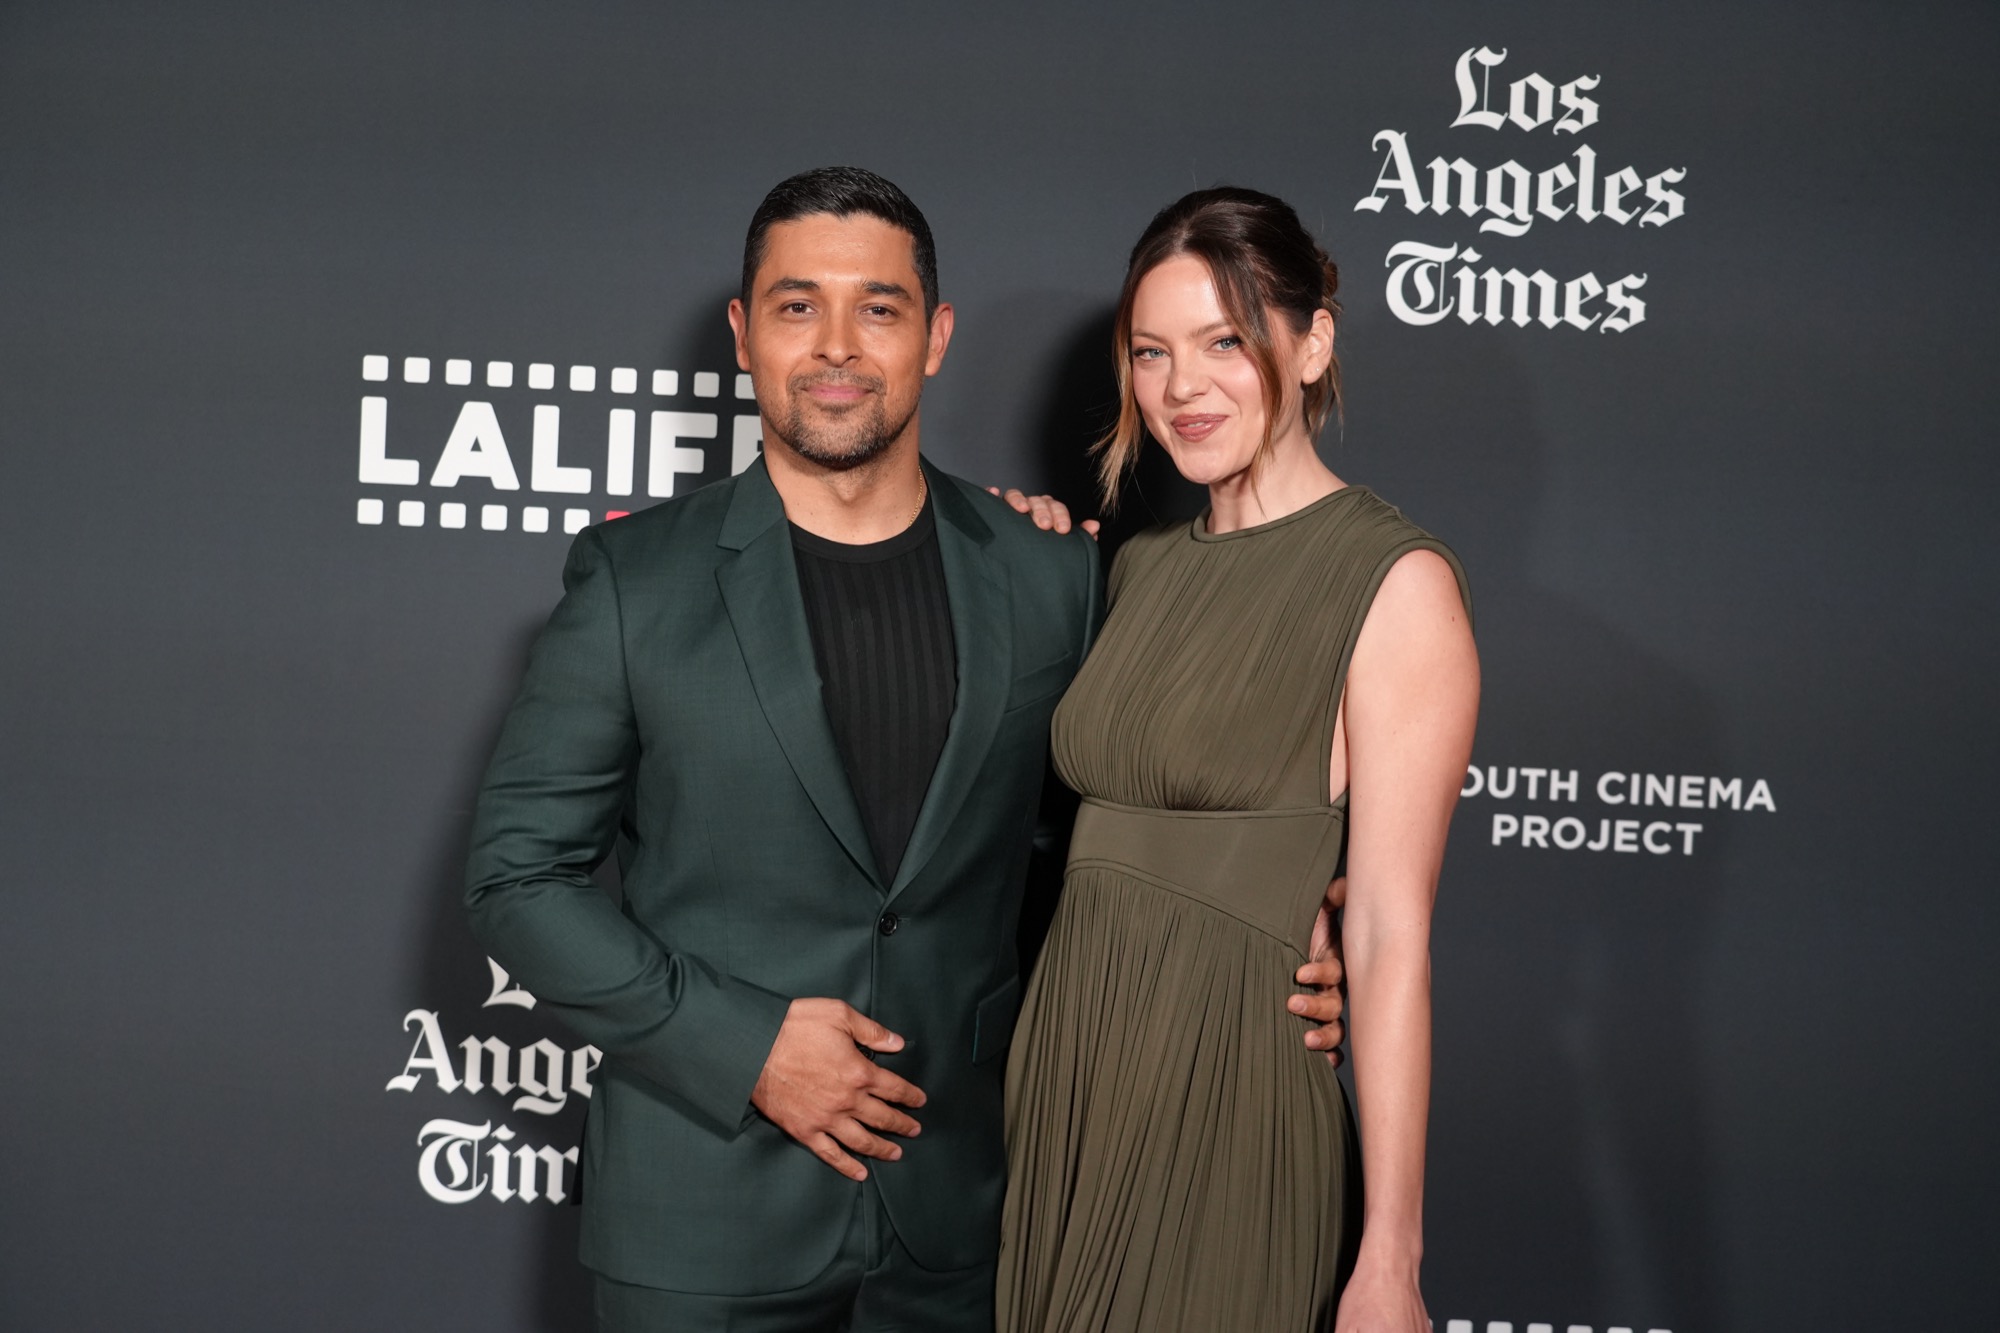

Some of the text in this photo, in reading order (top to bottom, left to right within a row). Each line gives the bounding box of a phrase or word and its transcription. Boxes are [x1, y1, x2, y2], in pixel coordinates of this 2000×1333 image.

[1450, 46, 1600, 135] Los
[1354, 130, 1686, 237] Angeles
[1385, 241, 1647, 333] Times
[1491, 813, 1703, 856] PROJECT
[1596, 771, 1776, 812] CINEMA
